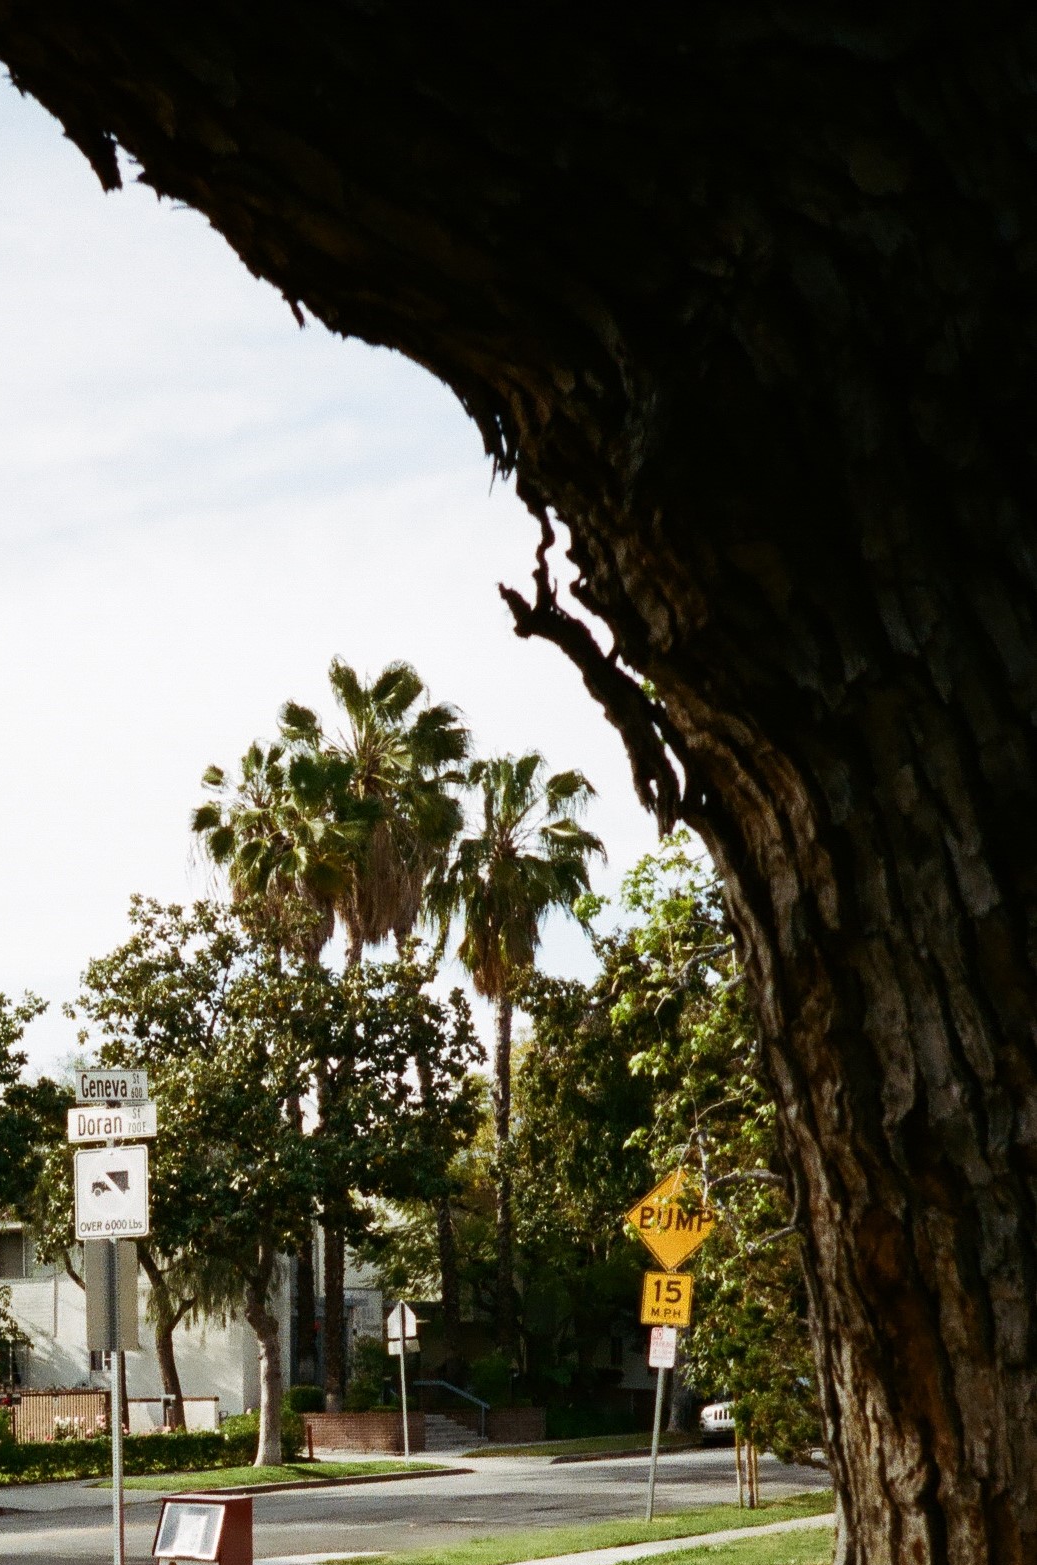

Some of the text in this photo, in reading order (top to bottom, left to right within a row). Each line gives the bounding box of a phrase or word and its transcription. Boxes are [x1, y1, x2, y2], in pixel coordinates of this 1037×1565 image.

[81, 1072, 140, 1098] Geneva St
[130, 1087, 143, 1099] 600
[77, 1107, 141, 1137] Doran St
[79, 1219, 143, 1232] OVER 6000 Lbs
[639, 1206, 714, 1232] BUMP
[654, 1279, 682, 1303] 15
[650, 1306, 681, 1318] MPH
